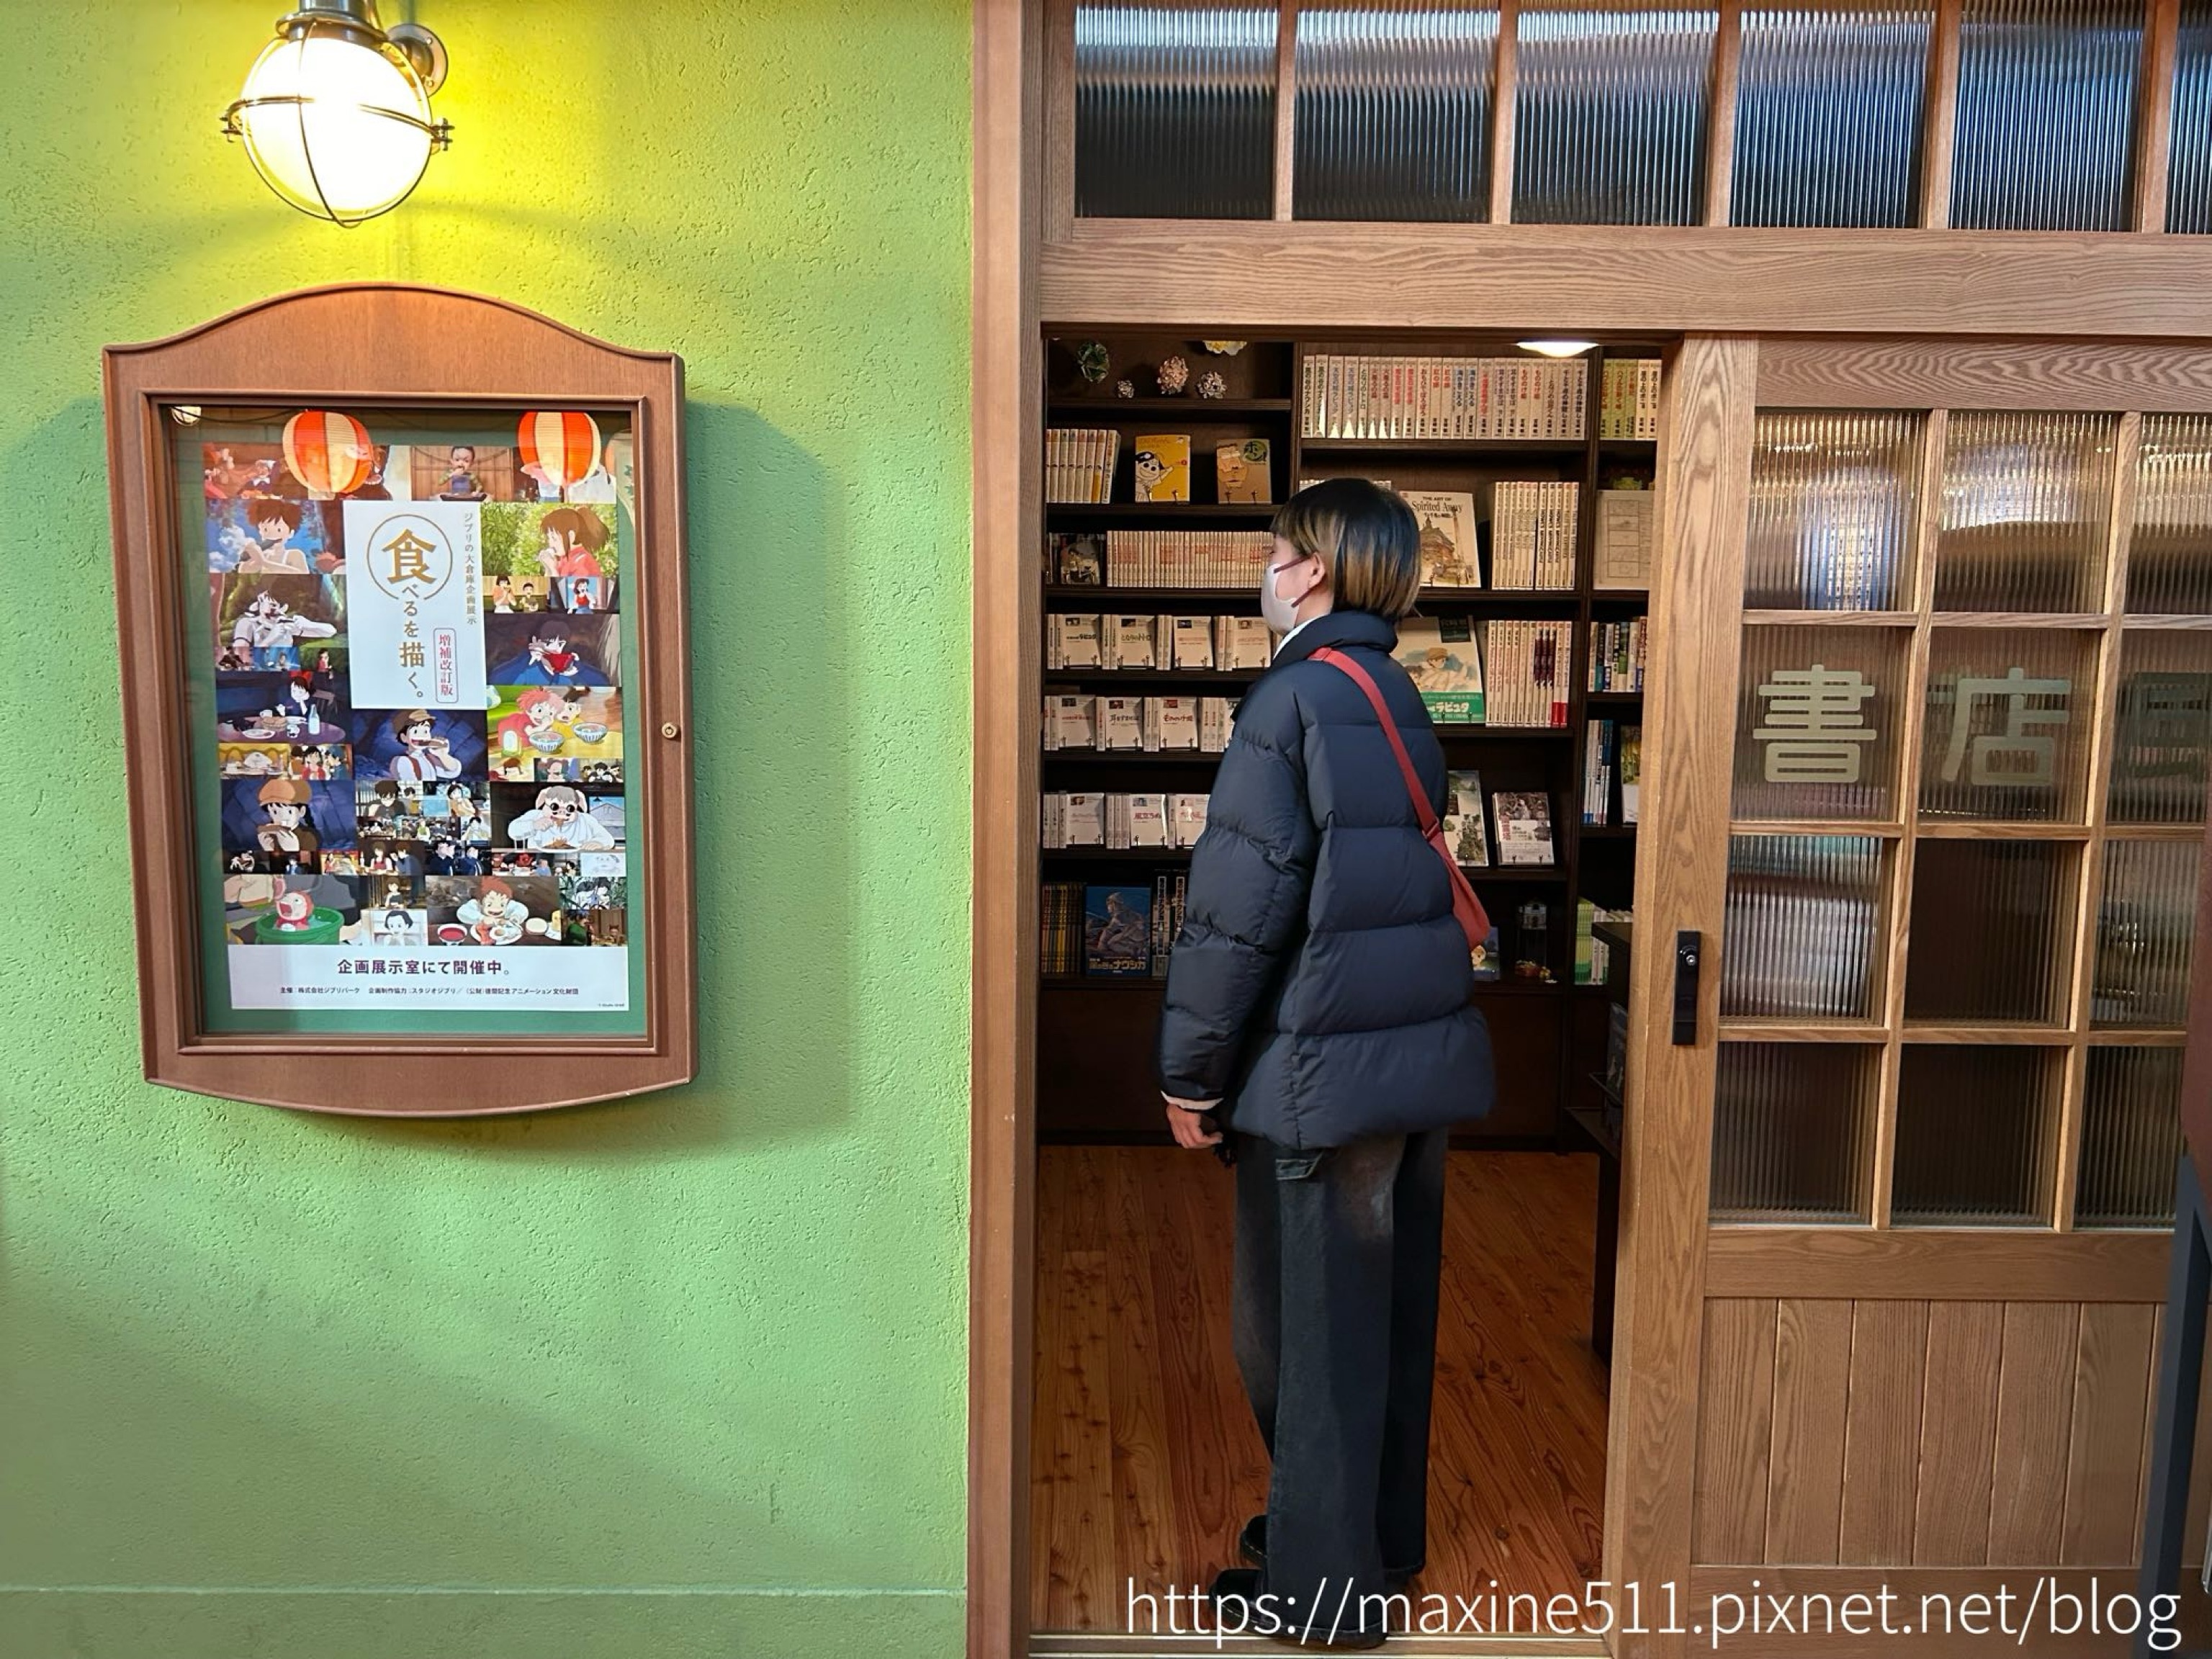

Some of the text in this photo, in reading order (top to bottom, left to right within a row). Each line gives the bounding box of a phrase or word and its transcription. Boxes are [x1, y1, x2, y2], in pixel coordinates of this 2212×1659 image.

[1411, 500, 1440, 513] Spirited
[464, 513, 477, 624] ジブリの大倉庫企画展示
[438, 633, 454, 697] 増補改訂版
[1753, 663, 2072, 787] 書店
[337, 959, 510, 976] 企画展示室にて開催中。
